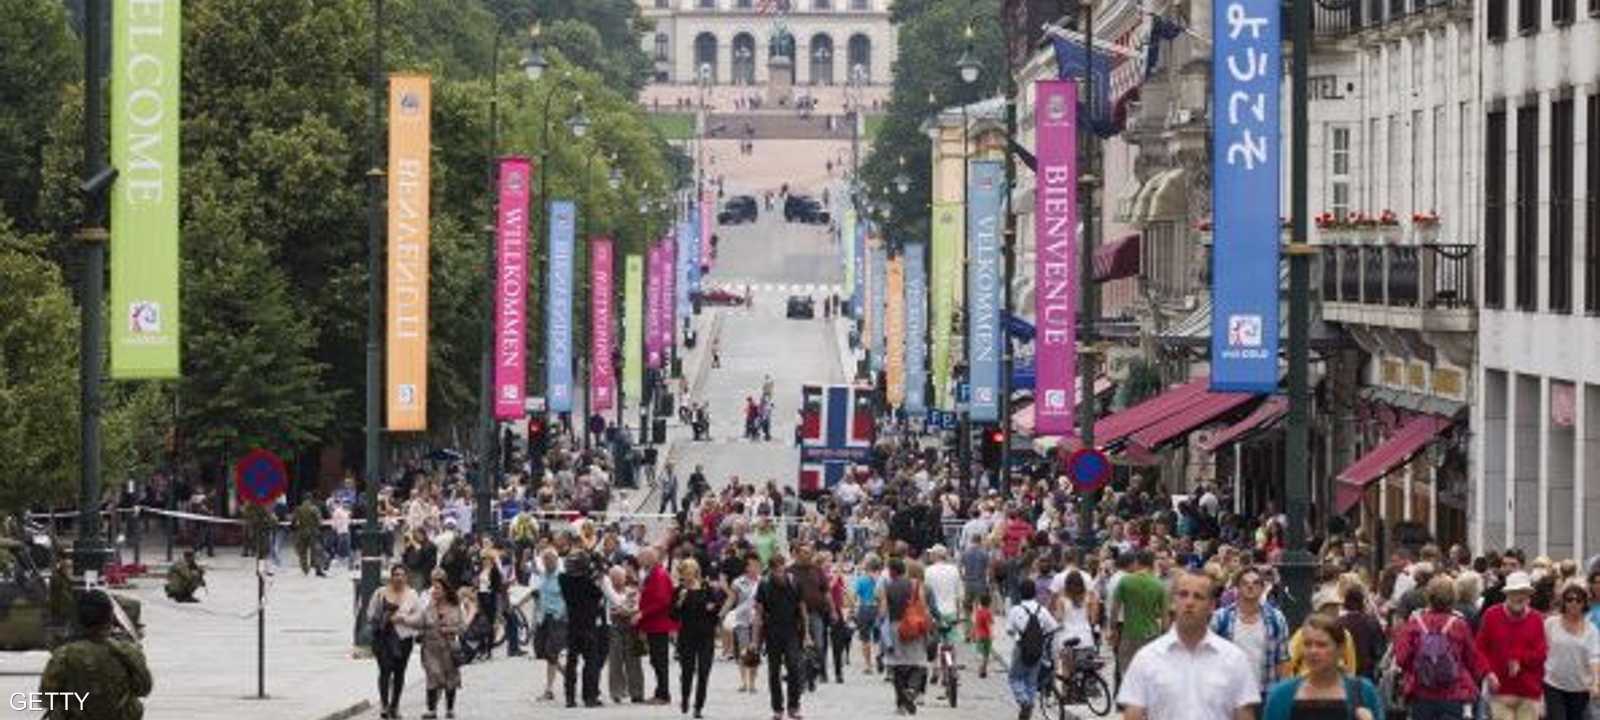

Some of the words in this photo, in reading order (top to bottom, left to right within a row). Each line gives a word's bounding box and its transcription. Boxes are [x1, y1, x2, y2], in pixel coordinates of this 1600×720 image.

[1227, 3, 1268, 170] ようこそ
[502, 208, 523, 367] WILLKOMMEN
[975, 214, 994, 362] VELKOMMEN
[1044, 164, 1069, 344] BIENVENUE
